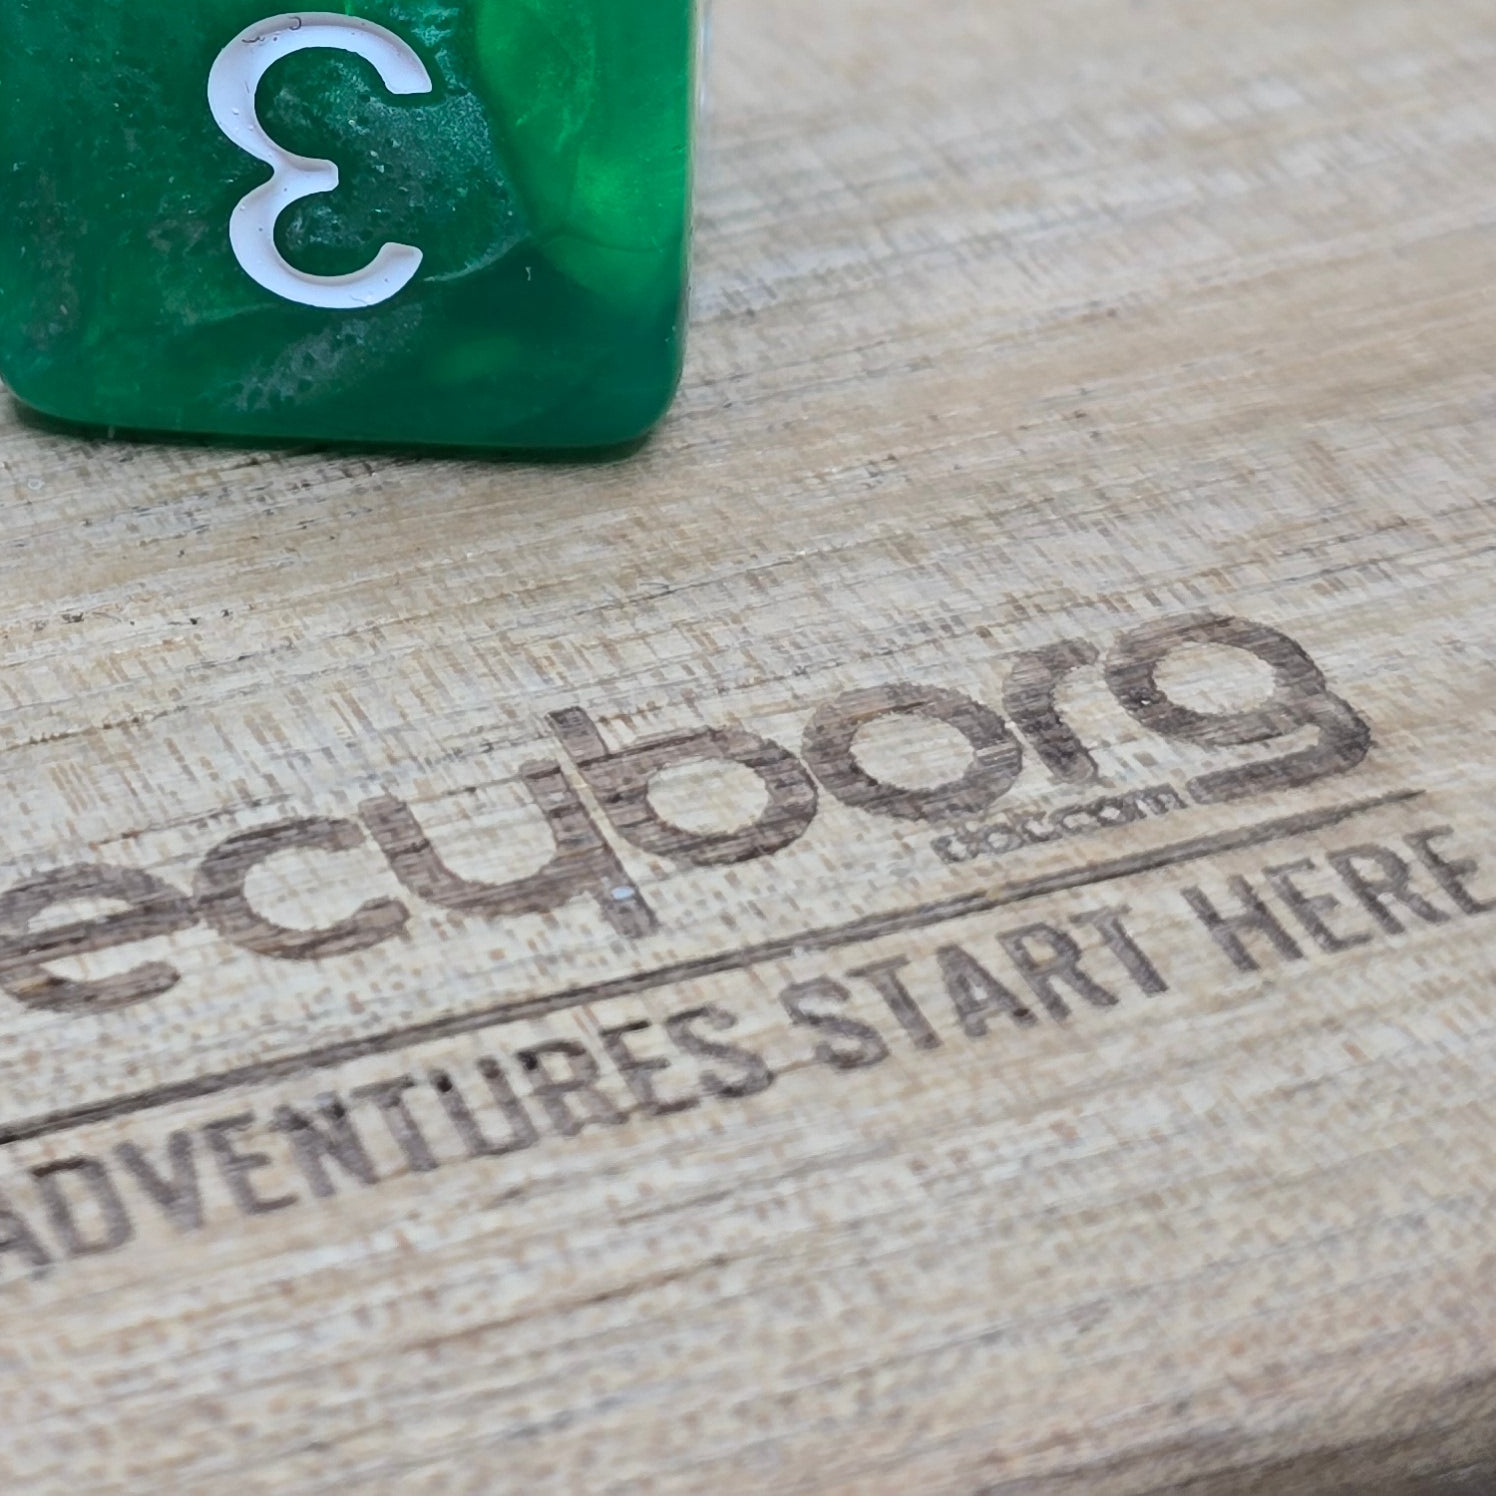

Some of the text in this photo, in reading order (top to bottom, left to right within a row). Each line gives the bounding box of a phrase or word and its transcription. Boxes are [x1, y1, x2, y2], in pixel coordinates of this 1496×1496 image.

[207, 11, 433, 308] 3
[779, 904, 1168, 1072] START
[1180, 824, 1496, 972] HERE
